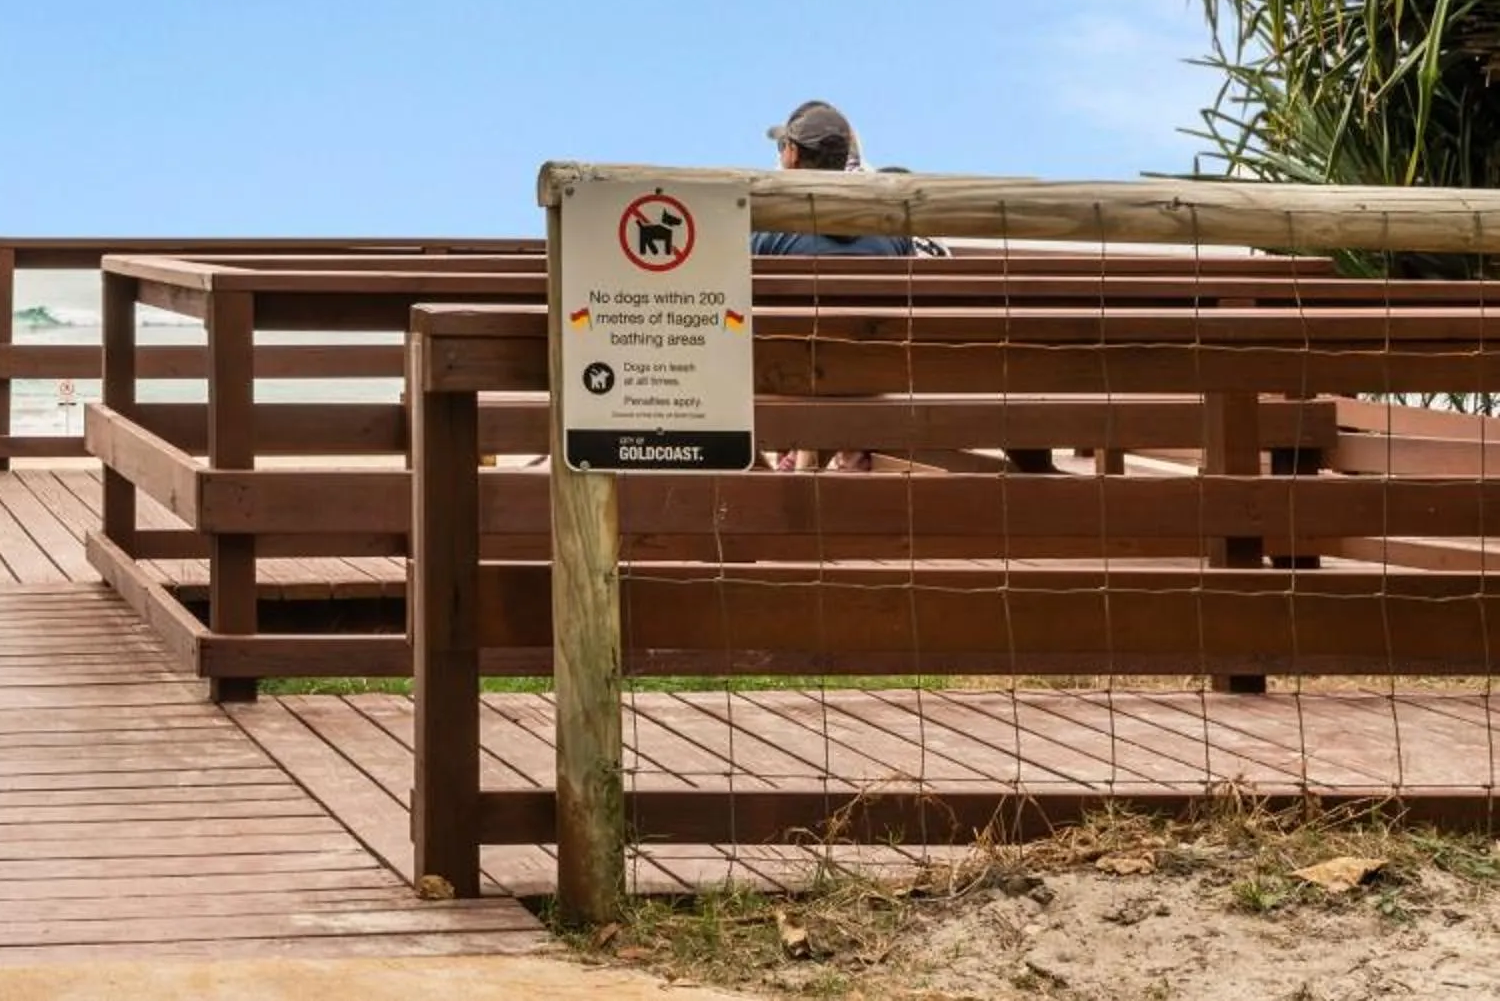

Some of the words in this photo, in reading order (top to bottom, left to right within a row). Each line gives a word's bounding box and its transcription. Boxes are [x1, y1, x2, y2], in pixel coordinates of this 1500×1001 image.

[589, 291, 611, 304] No
[614, 291, 649, 307] dogs
[653, 291, 695, 304] within
[698, 292, 725, 305] 200
[596, 313, 645, 325] metres
[649, 312, 663, 325] of
[666, 312, 719, 328] flagged
[611, 332, 663, 347] bathing
[667, 335, 706, 346] areas
[623, 362, 651, 374] Dogs
[653, 363, 667, 372] on
